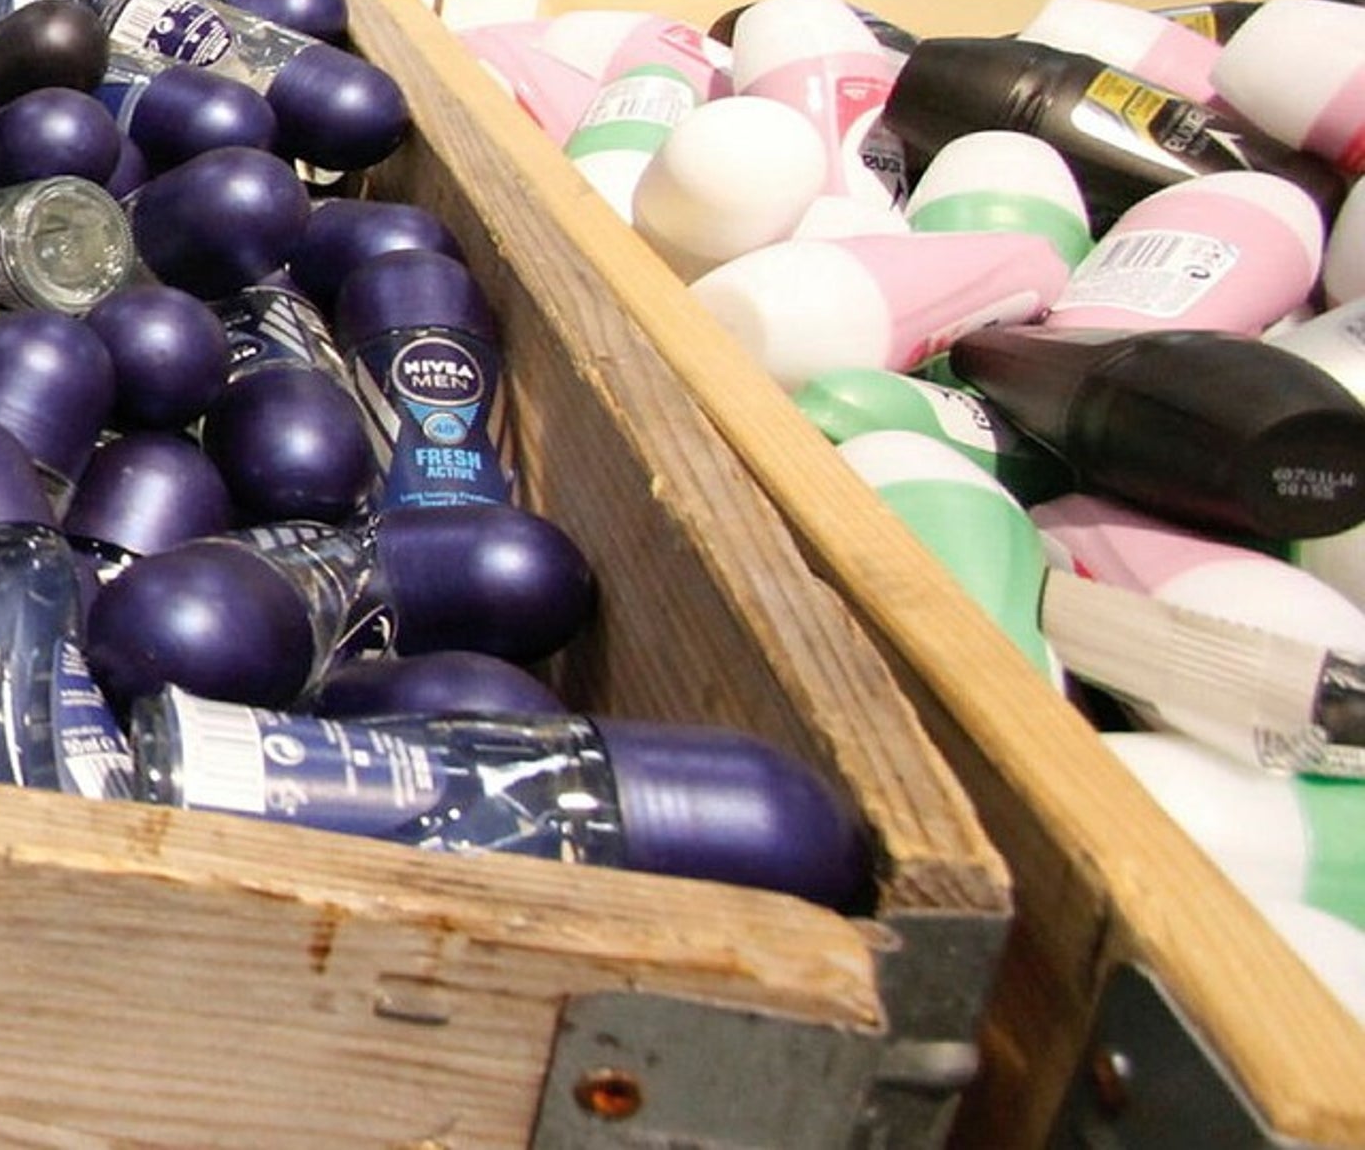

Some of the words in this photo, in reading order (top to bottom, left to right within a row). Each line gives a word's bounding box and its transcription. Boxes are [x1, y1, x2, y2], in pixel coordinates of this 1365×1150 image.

[403, 359, 475, 380] NIVEA
[412, 374, 469, 390] MEN
[415, 447, 483, 470] FRESH
[425, 466, 477, 481] ACTIVE
